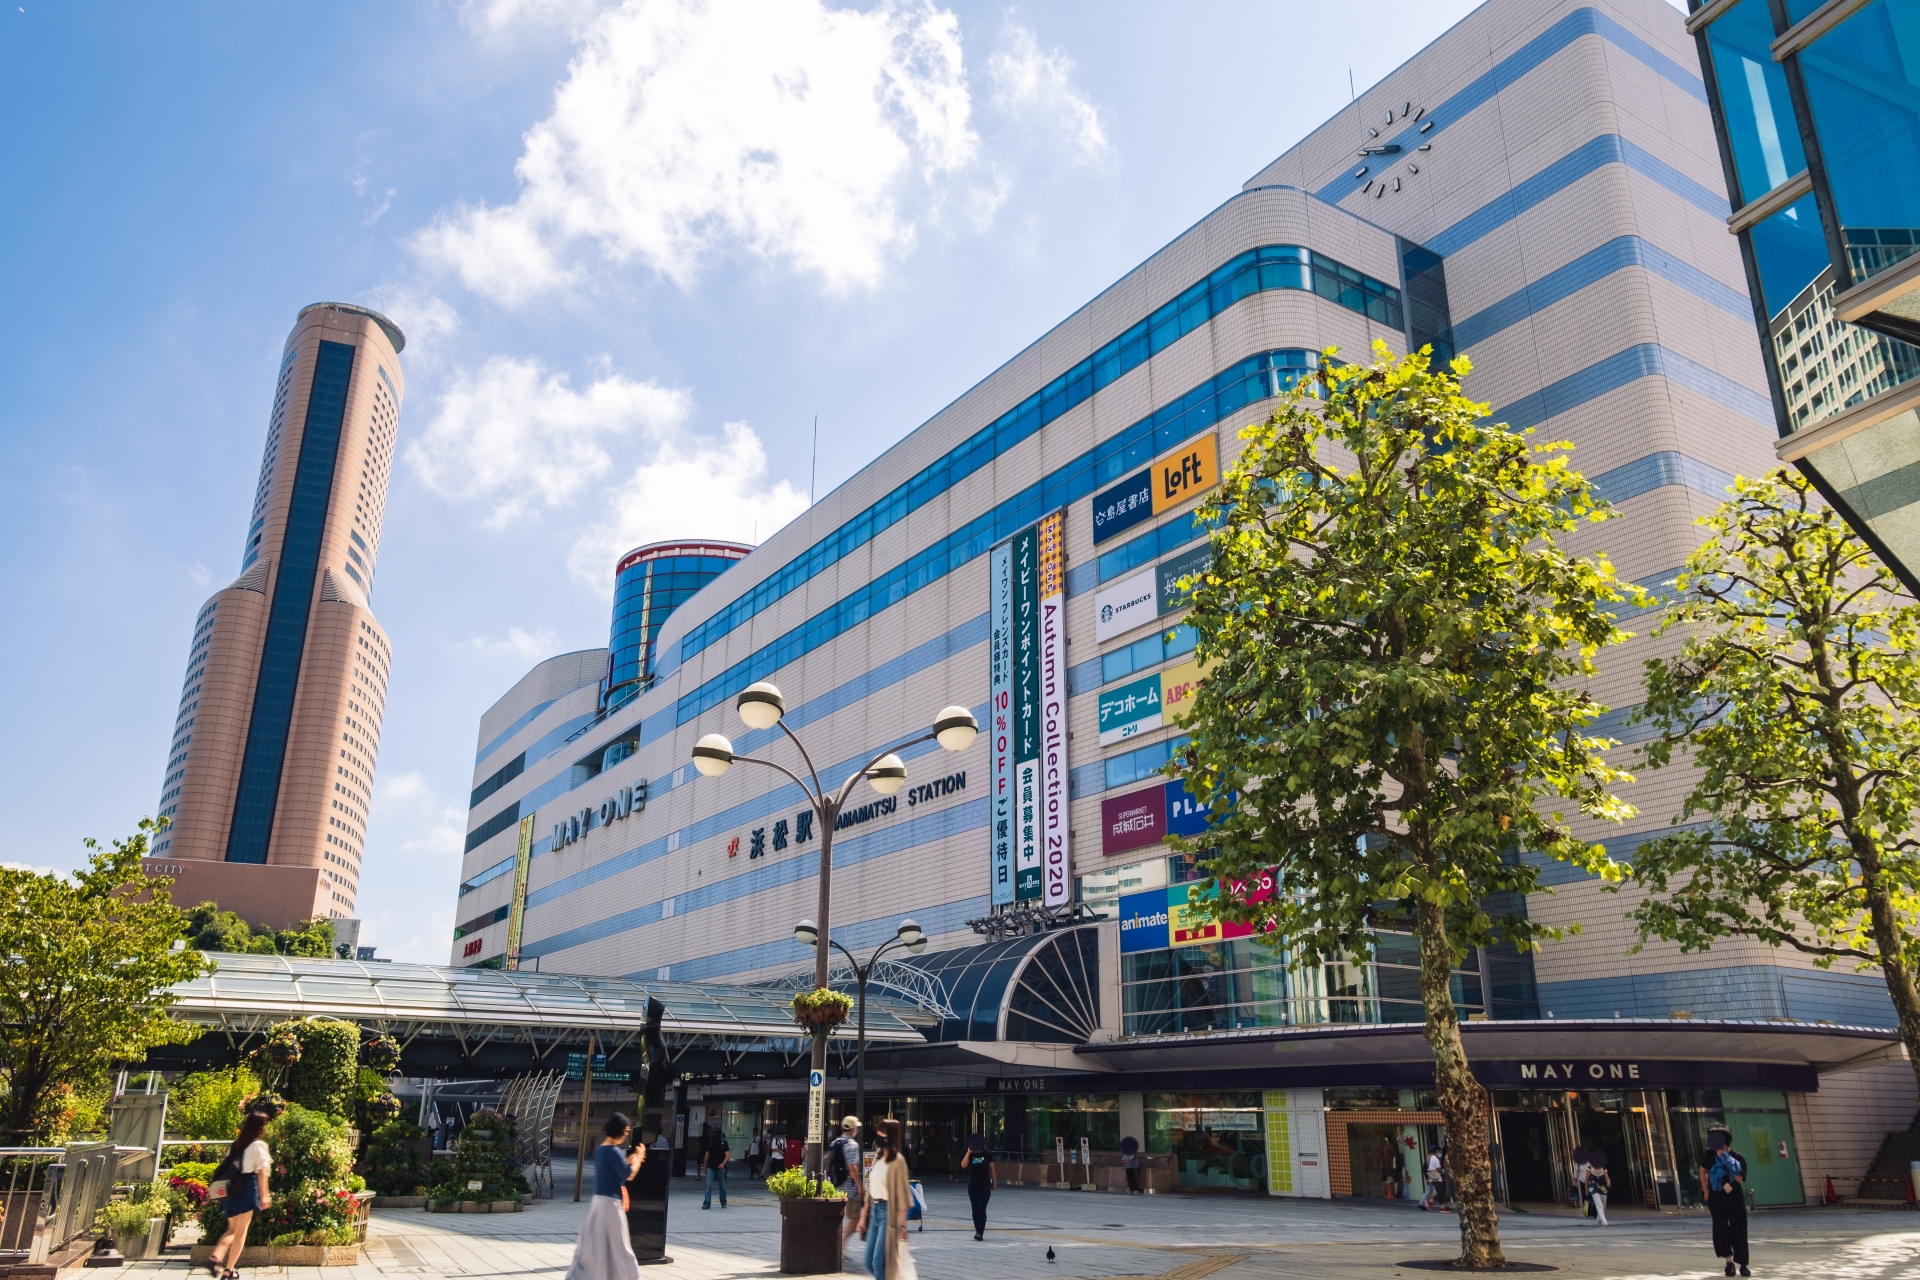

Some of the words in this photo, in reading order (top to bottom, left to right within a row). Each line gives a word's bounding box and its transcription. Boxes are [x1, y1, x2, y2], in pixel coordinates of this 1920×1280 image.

[1115, 593, 1151, 613] STARBUCKS
[1044, 604, 1057, 697] Autumn
[1101, 687, 1158, 722] デコホーム
[1122, 724, 1138, 737] ニトリ
[1046, 702, 1062, 829] Collection
[908, 771, 966, 806] STATION
[551, 807, 592, 852] MAY
[599, 778, 647, 827] ONE
[833, 795, 897, 832] AMAMATSU
[1022, 767, 1034, 862] 会員募集中
[1113, 813, 1154, 836] 成城石井
[1118, 806, 1147, 819] SUPERMARKET
[750, 810, 813, 859] 浜松駅
[155, 864, 186, 875] CITY
[1048, 835, 1064, 897] 2020
[1121, 912, 1168, 931] animate
[999, 1080, 1019, 1090] MAY
[1024, 1079, 1045, 1090] ONE
[1521, 1064, 1574, 1079] MAY
[1589, 1064, 1640, 1079] ONE
